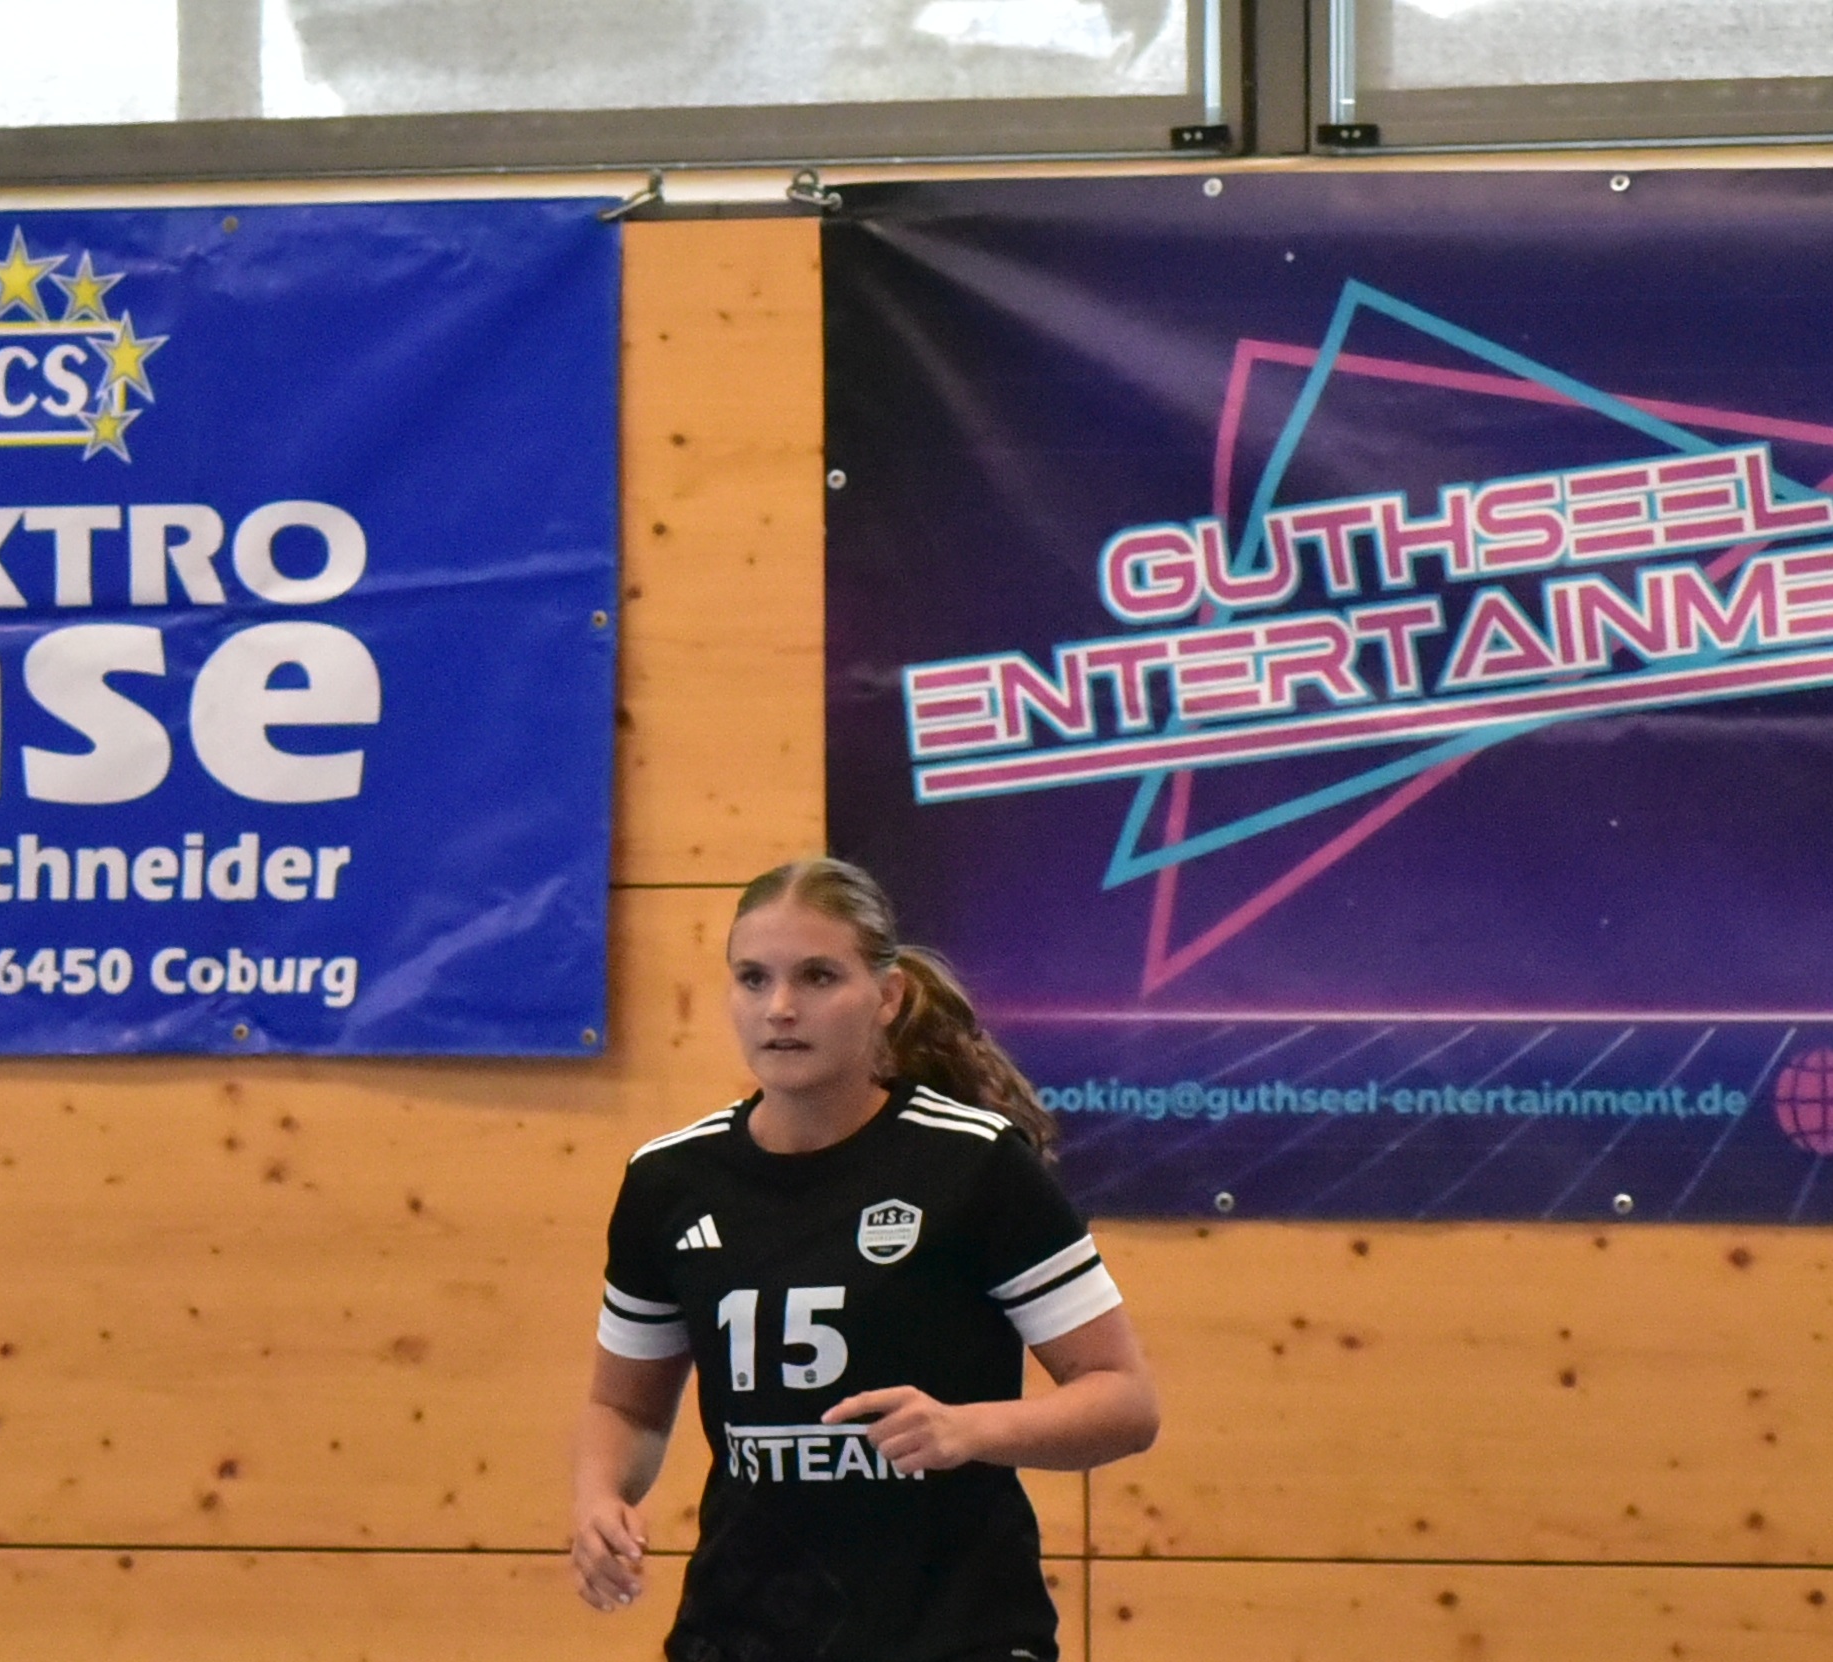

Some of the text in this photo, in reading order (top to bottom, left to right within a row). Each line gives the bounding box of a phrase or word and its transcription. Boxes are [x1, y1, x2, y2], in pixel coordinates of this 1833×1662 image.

[1099, 442, 1833, 624] GUTHSEEL
[149, 947, 360, 1009] Coburg
[1036, 1078, 1748, 1121] ooking@guthseel-entertainment.de
[716, 1285, 849, 1392] 15
